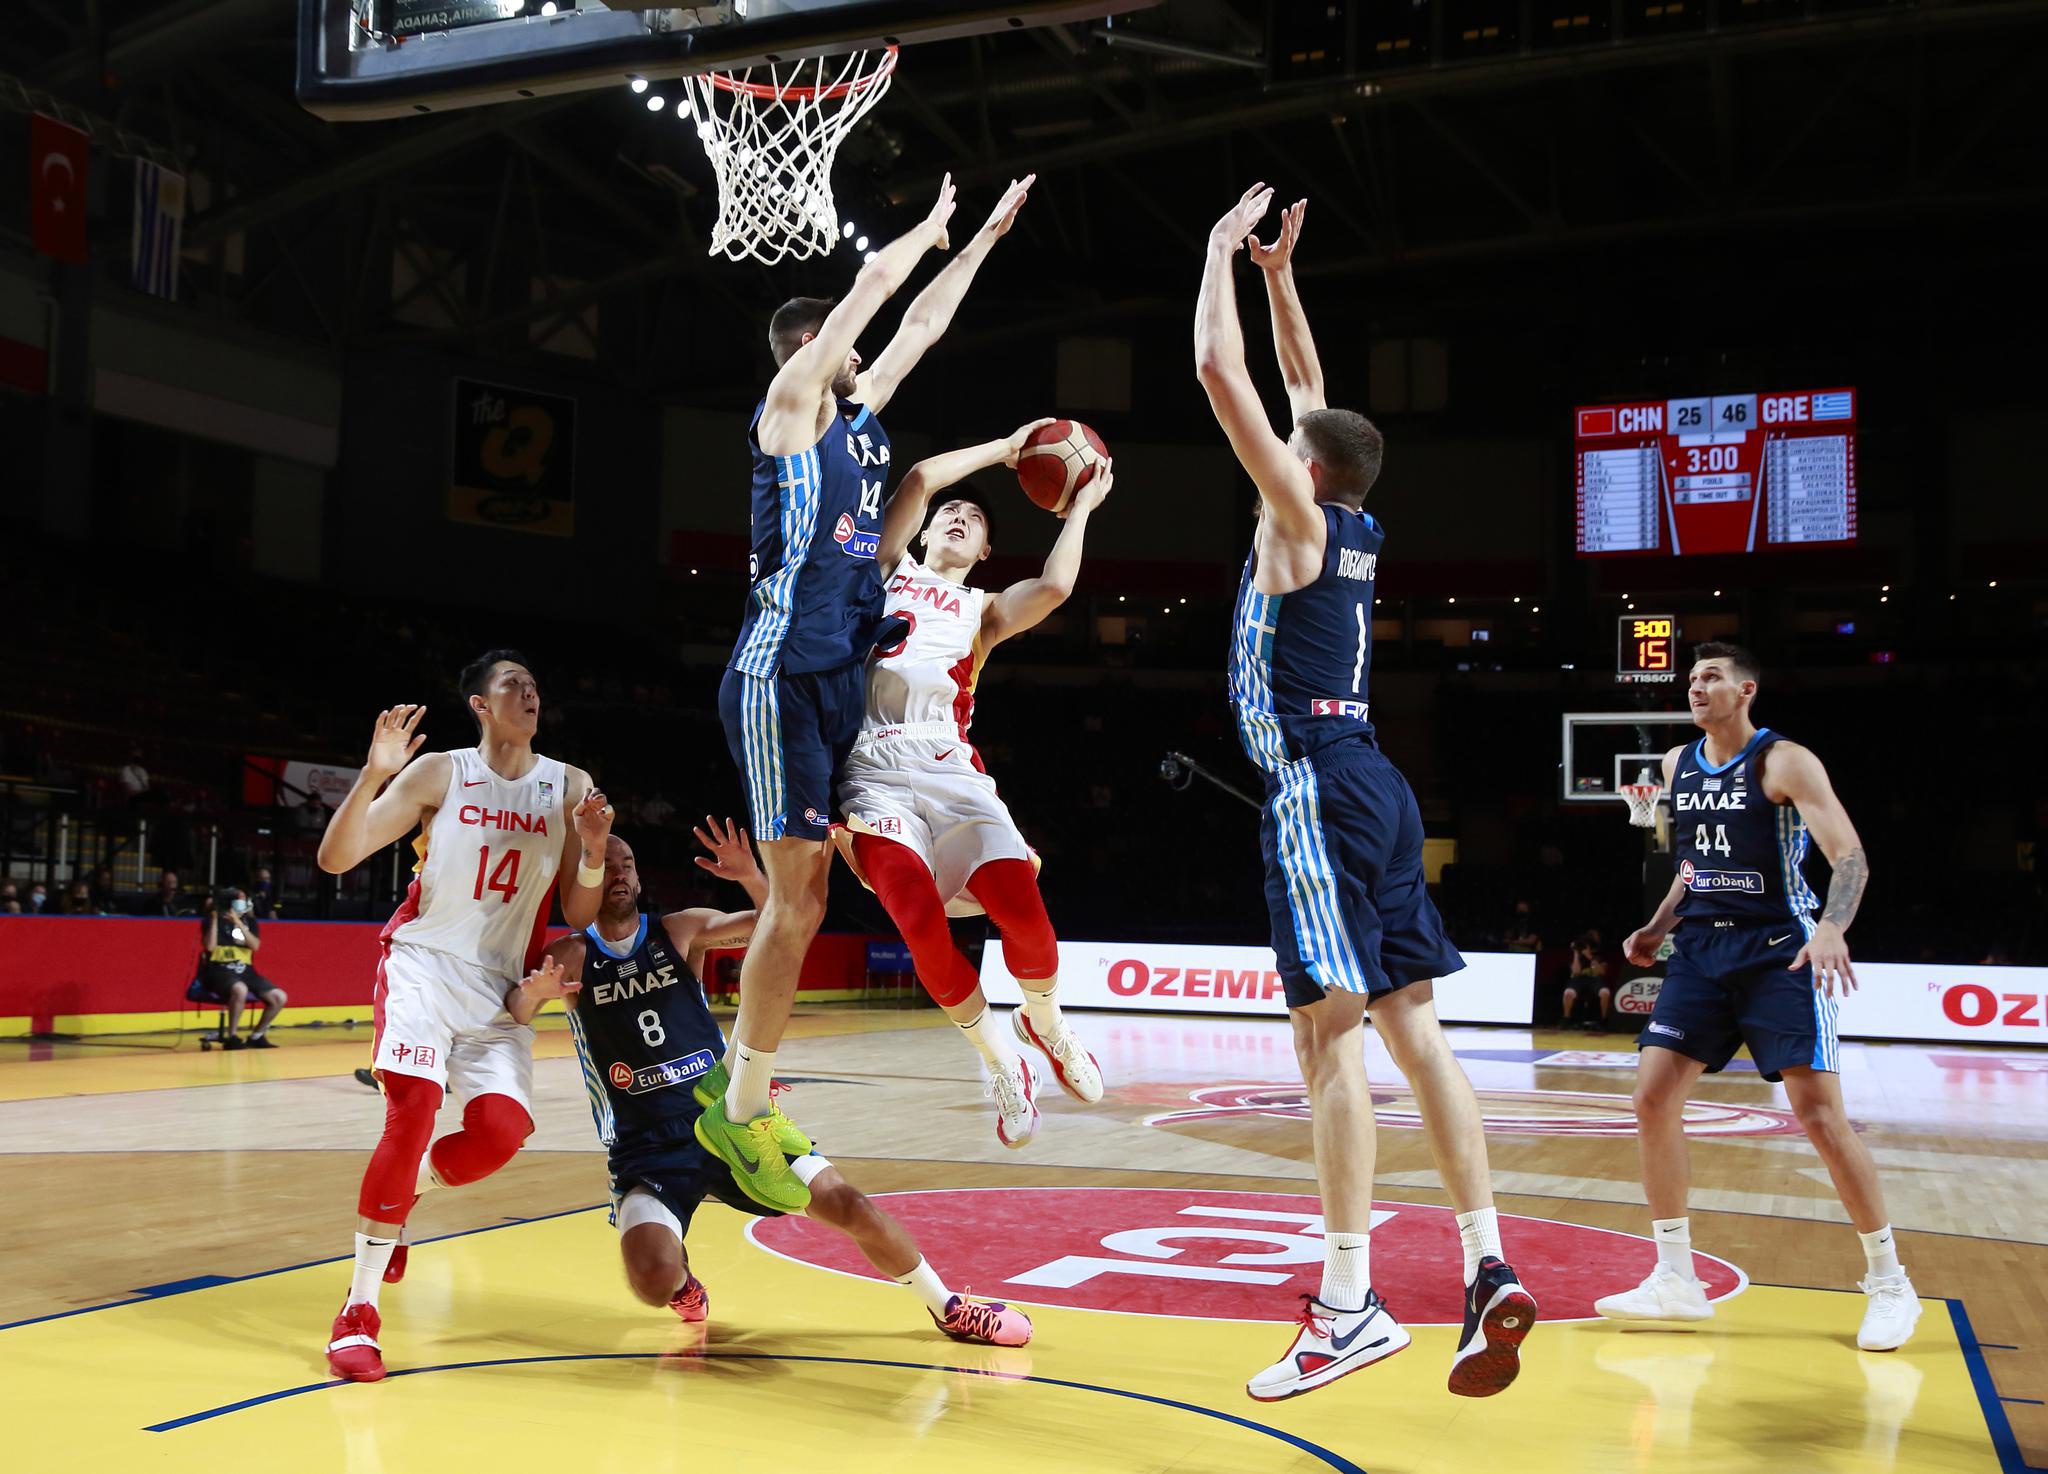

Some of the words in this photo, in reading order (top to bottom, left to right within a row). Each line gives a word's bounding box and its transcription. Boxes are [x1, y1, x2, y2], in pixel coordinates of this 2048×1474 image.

[1618, 406, 1663, 433] CHN
[1678, 406, 1702, 426] 25
[1722, 403, 1747, 422] 46
[1762, 396, 1809, 423] GRE
[1687, 446, 1739, 473] 3:00
[857, 478, 882, 520] 14
[1633, 620, 1671, 638] 3:00
[1352, 602, 1367, 694] 1
[1639, 640, 1667, 669] 15
[1632, 674, 1677, 683] TISSOT
[877, 728, 902, 739] CHN
[459, 804, 548, 838] CHINA
[1695, 823, 1731, 858] 44
[473, 845, 522, 904] 14
[1696, 872, 1755, 889] Eurobank
[1942, 984, 2048, 1028] OZ
[637, 1009, 666, 1048] 8
[391, 1043, 436, 1069] 中国
[637, 1056, 708, 1088] Eurobank
